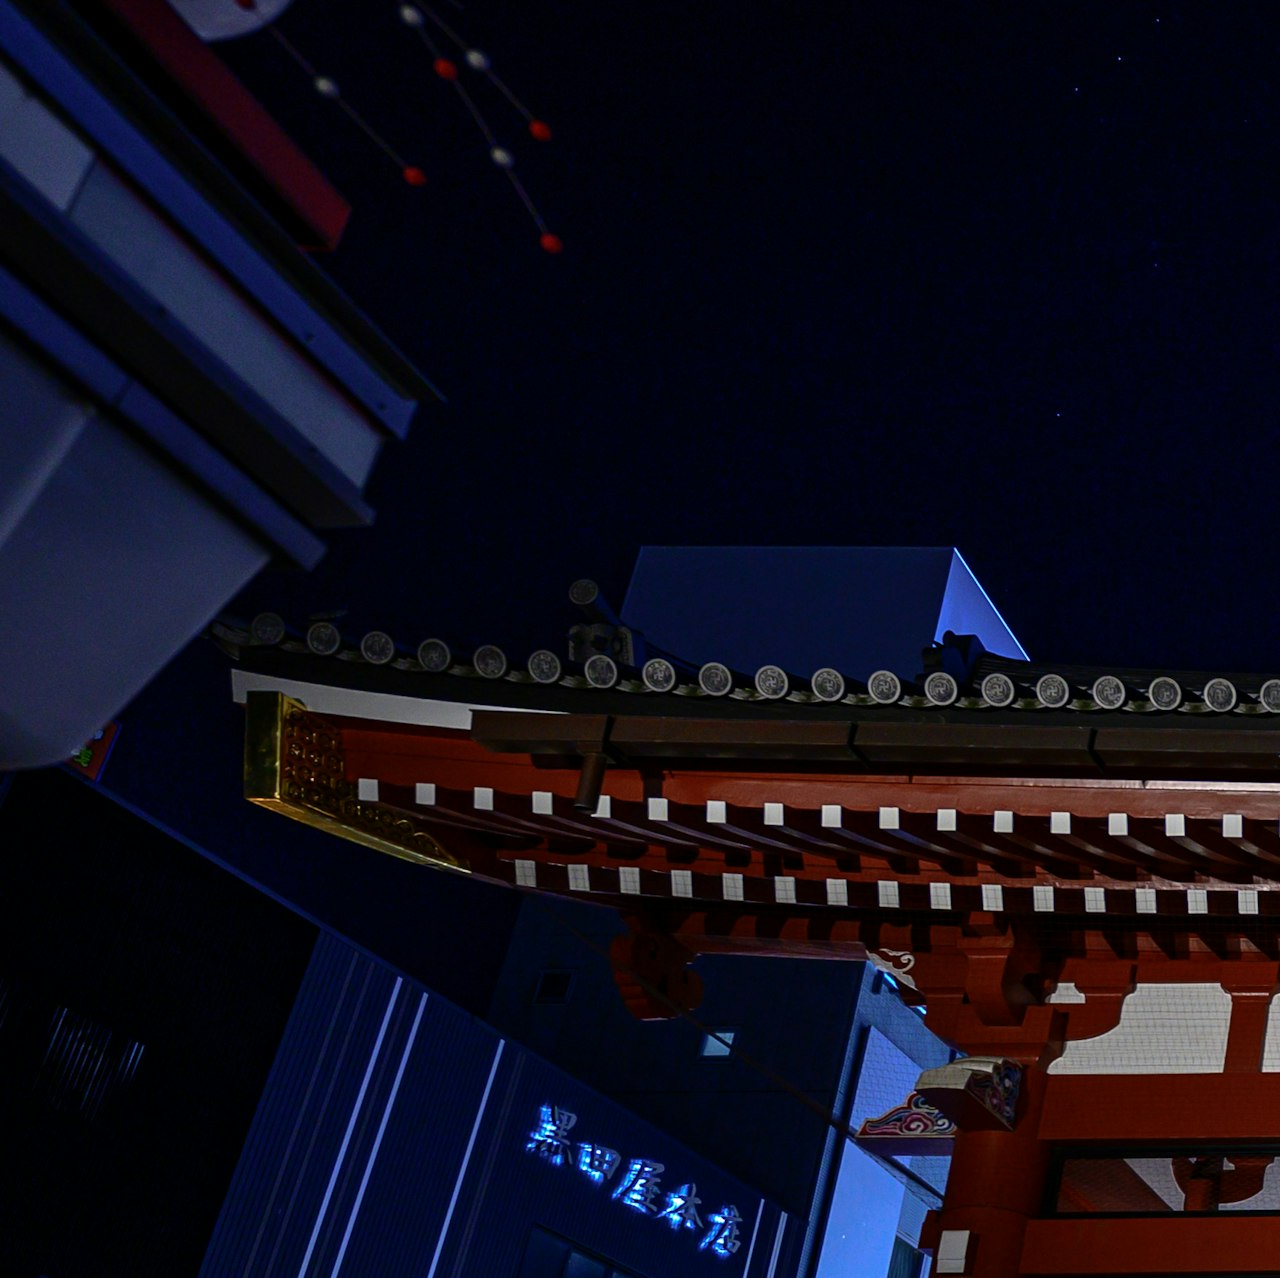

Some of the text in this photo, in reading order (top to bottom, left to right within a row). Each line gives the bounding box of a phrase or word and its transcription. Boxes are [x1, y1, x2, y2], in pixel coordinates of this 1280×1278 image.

[526, 1103, 743, 1256] 黒田屋本店
